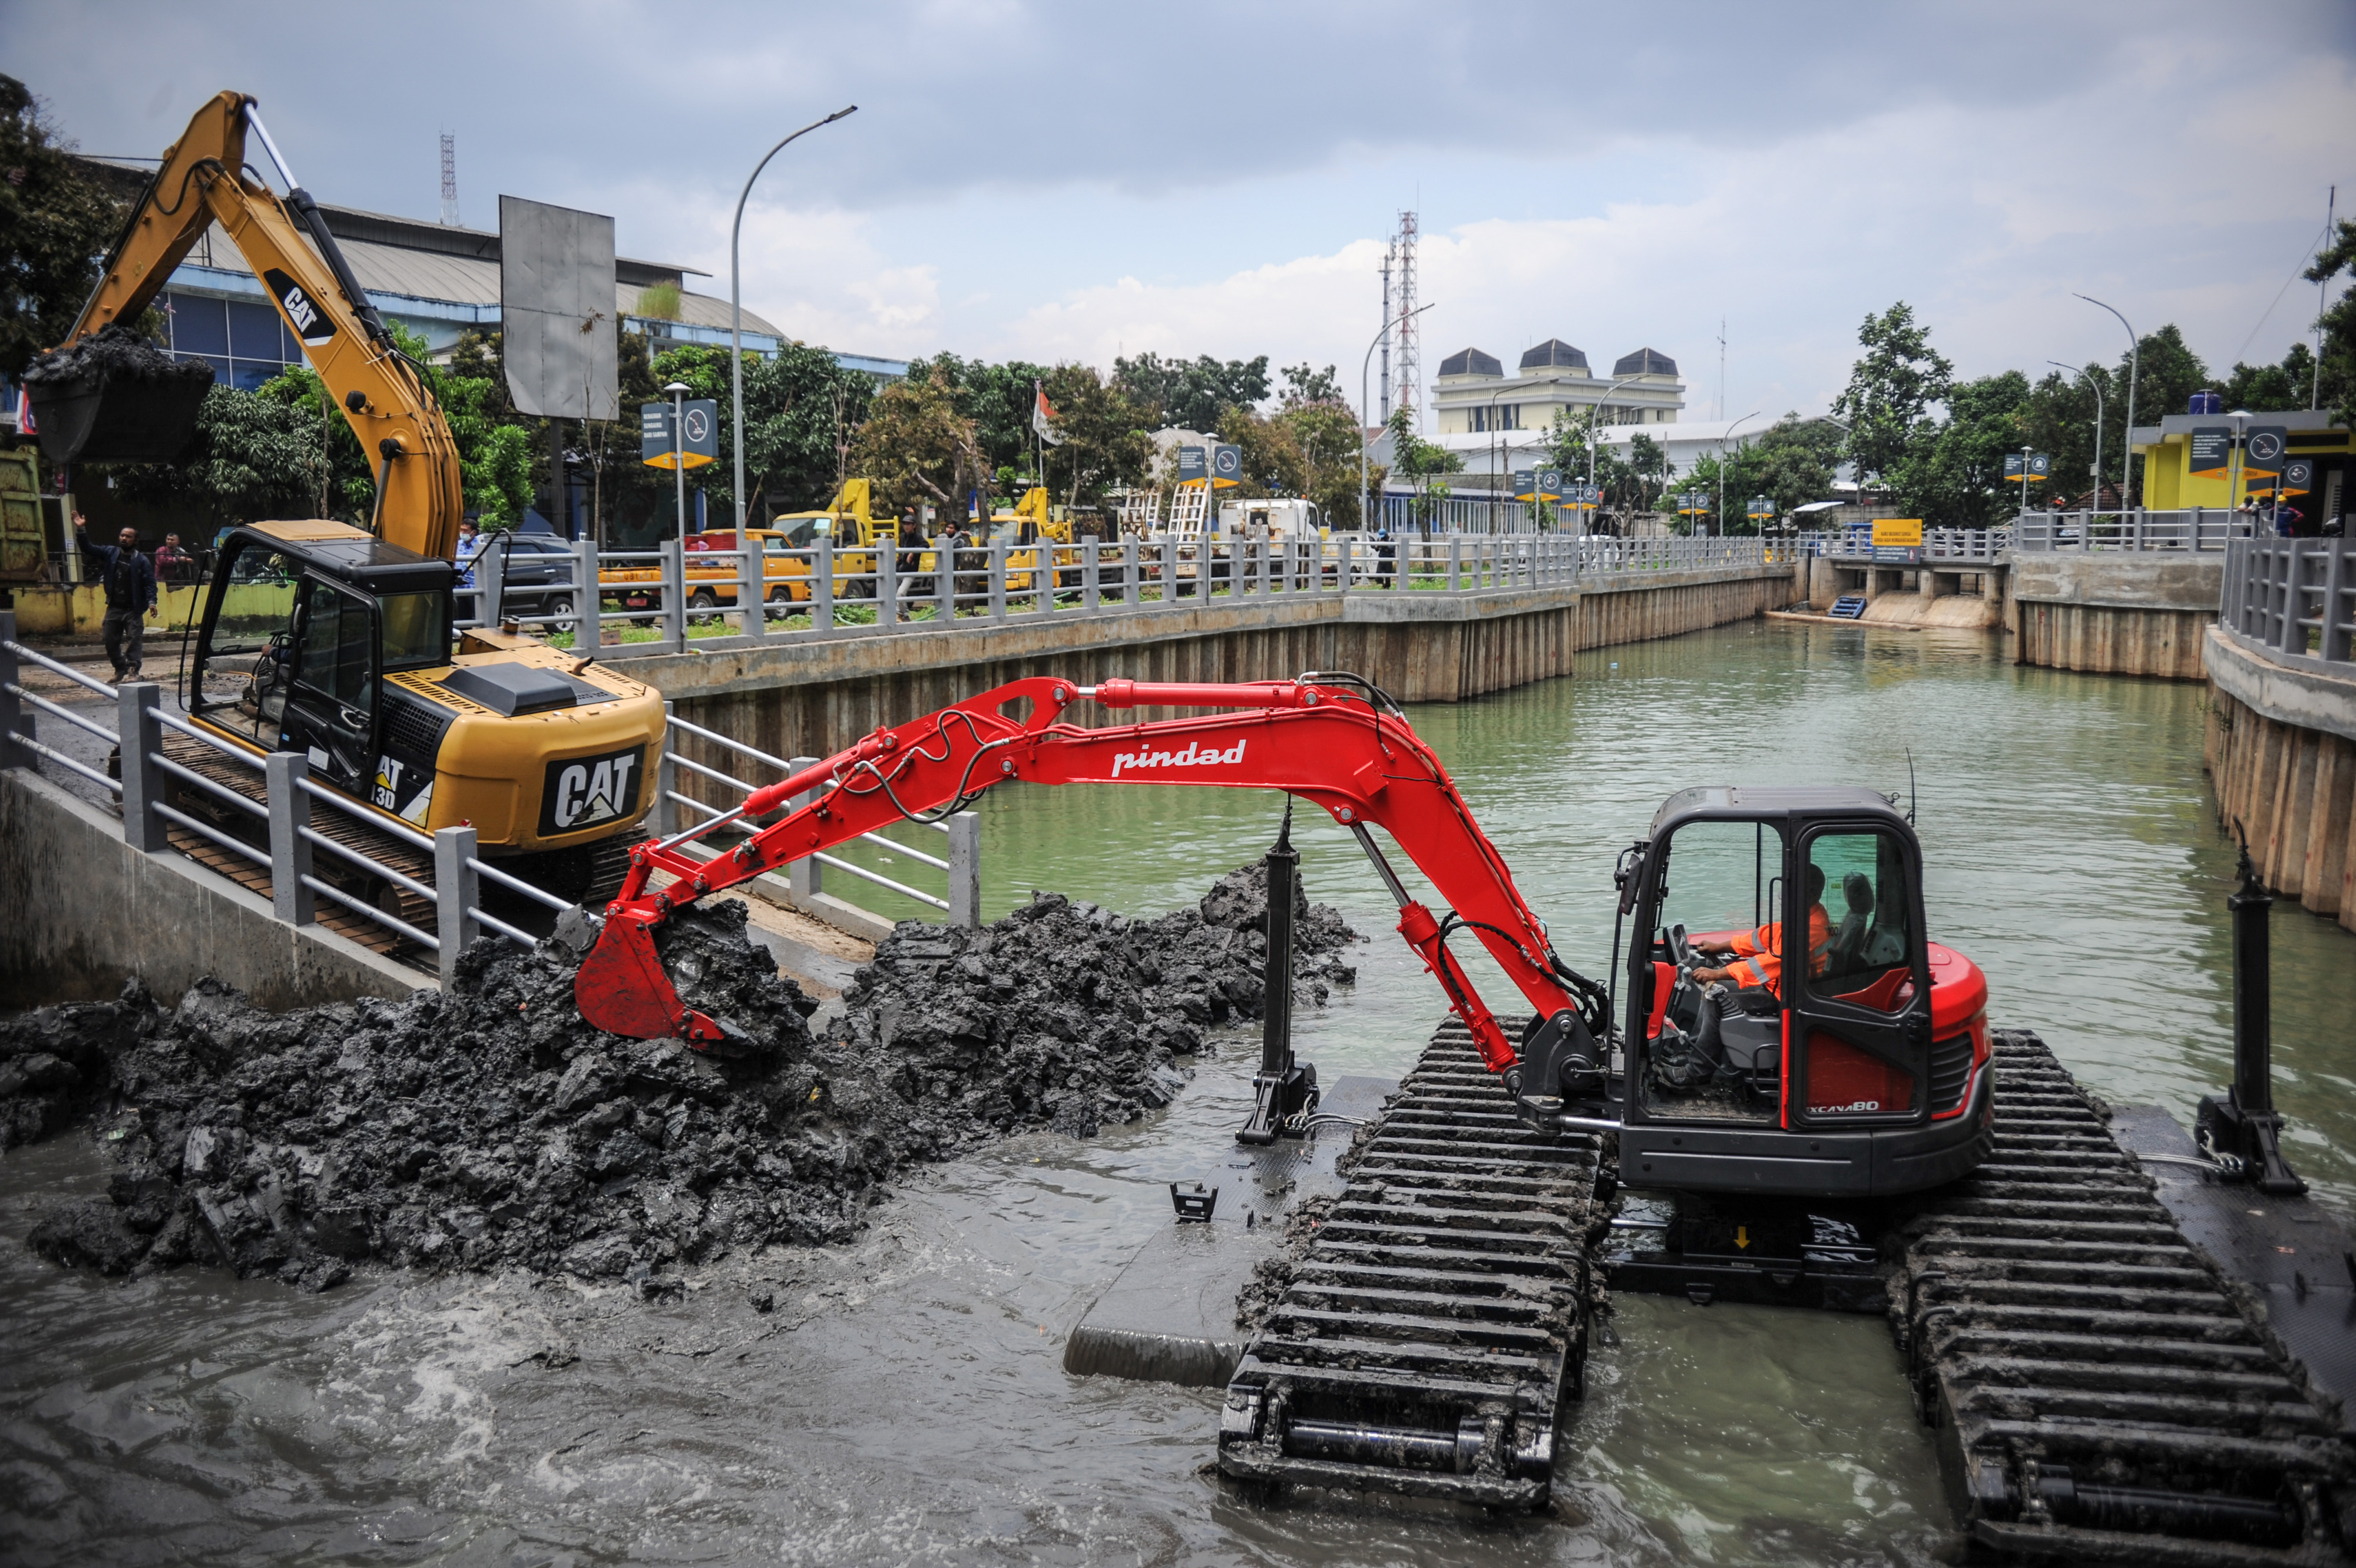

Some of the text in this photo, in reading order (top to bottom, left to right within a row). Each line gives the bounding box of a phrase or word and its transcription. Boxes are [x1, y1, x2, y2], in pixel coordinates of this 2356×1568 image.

[284, 287, 317, 333] CAT
[376, 754, 404, 792] AT
[1111, 739, 1247, 778] pindad
[554, 753, 635, 828] CAT
